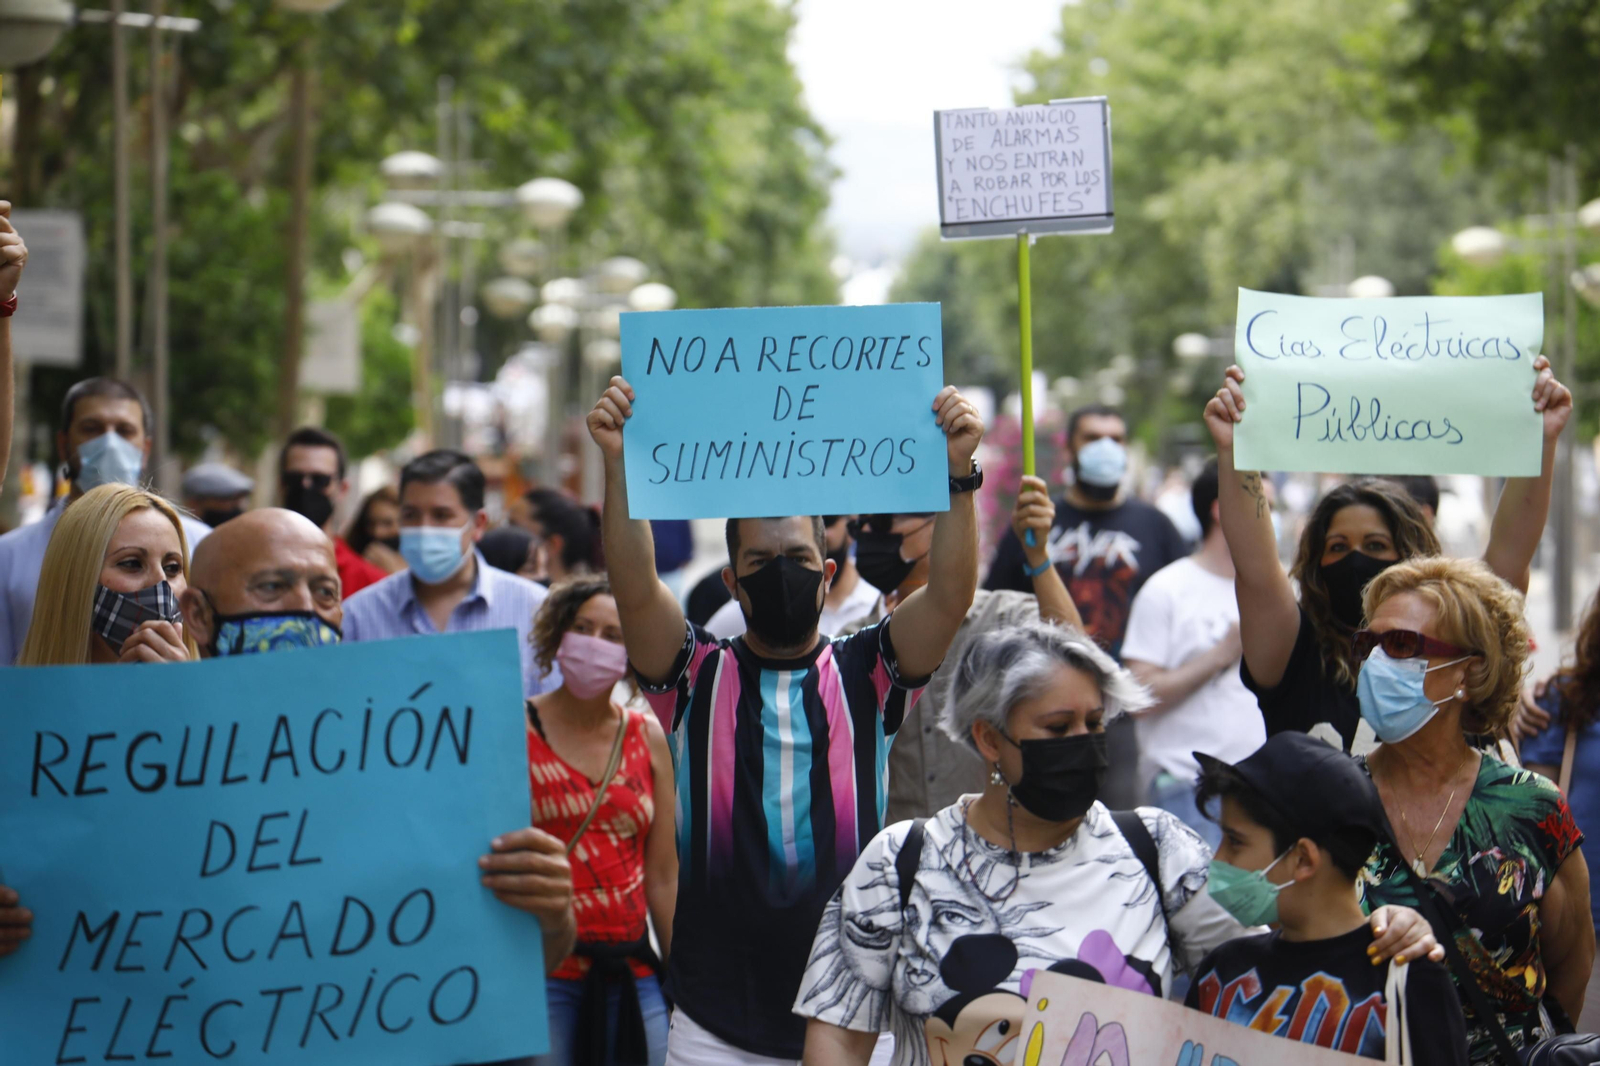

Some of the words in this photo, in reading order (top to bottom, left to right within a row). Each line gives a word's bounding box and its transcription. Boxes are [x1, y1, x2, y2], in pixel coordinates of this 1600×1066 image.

[943, 111, 998, 130] TANTO
[1004, 108, 1077, 127] ANUNCIO
[952, 135, 976, 153] DE
[990, 125, 1080, 149] ALARMAS
[945, 157, 955, 174] Y
[965, 152, 1008, 173] NOS
[1013, 149, 1085, 170] ENTRAN
[950, 179, 962, 194] A
[973, 172, 1033, 192] ROBAR
[1040, 171, 1068, 189] POR
[1074, 168, 1101, 187] LOS
[757, 335, 932, 373] RECORTES
[1338, 311, 1521, 361] Eléctricas
[772, 384, 820, 421] DE
[1292, 382, 1464, 445] Públicas
[648, 430, 917, 485] SUMINISTROS
[30, 681, 474, 798] REGULACIÓN
[200, 808, 323, 878] DEL
[58, 887, 437, 972] MERCADO
[55, 964, 481, 1066] ELÉCTRICO
